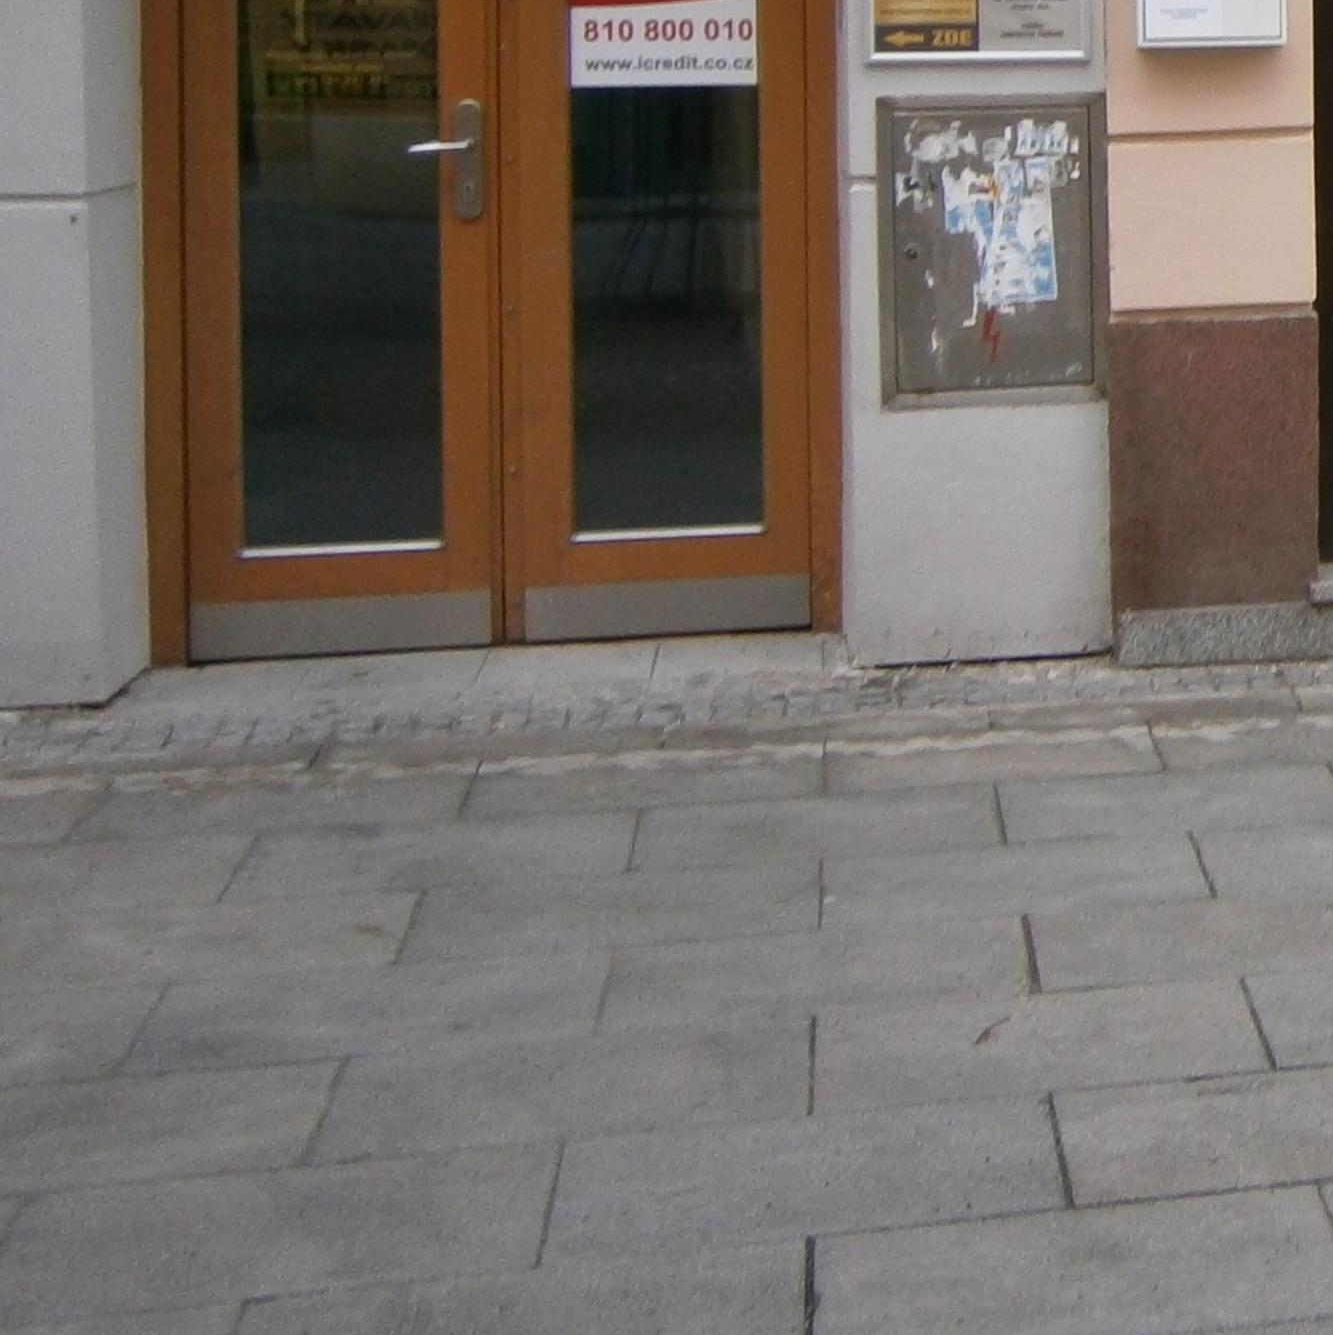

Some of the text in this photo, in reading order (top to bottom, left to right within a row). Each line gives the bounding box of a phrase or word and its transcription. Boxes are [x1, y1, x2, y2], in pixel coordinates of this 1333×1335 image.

[584, 18, 753, 42] 810 800 010
